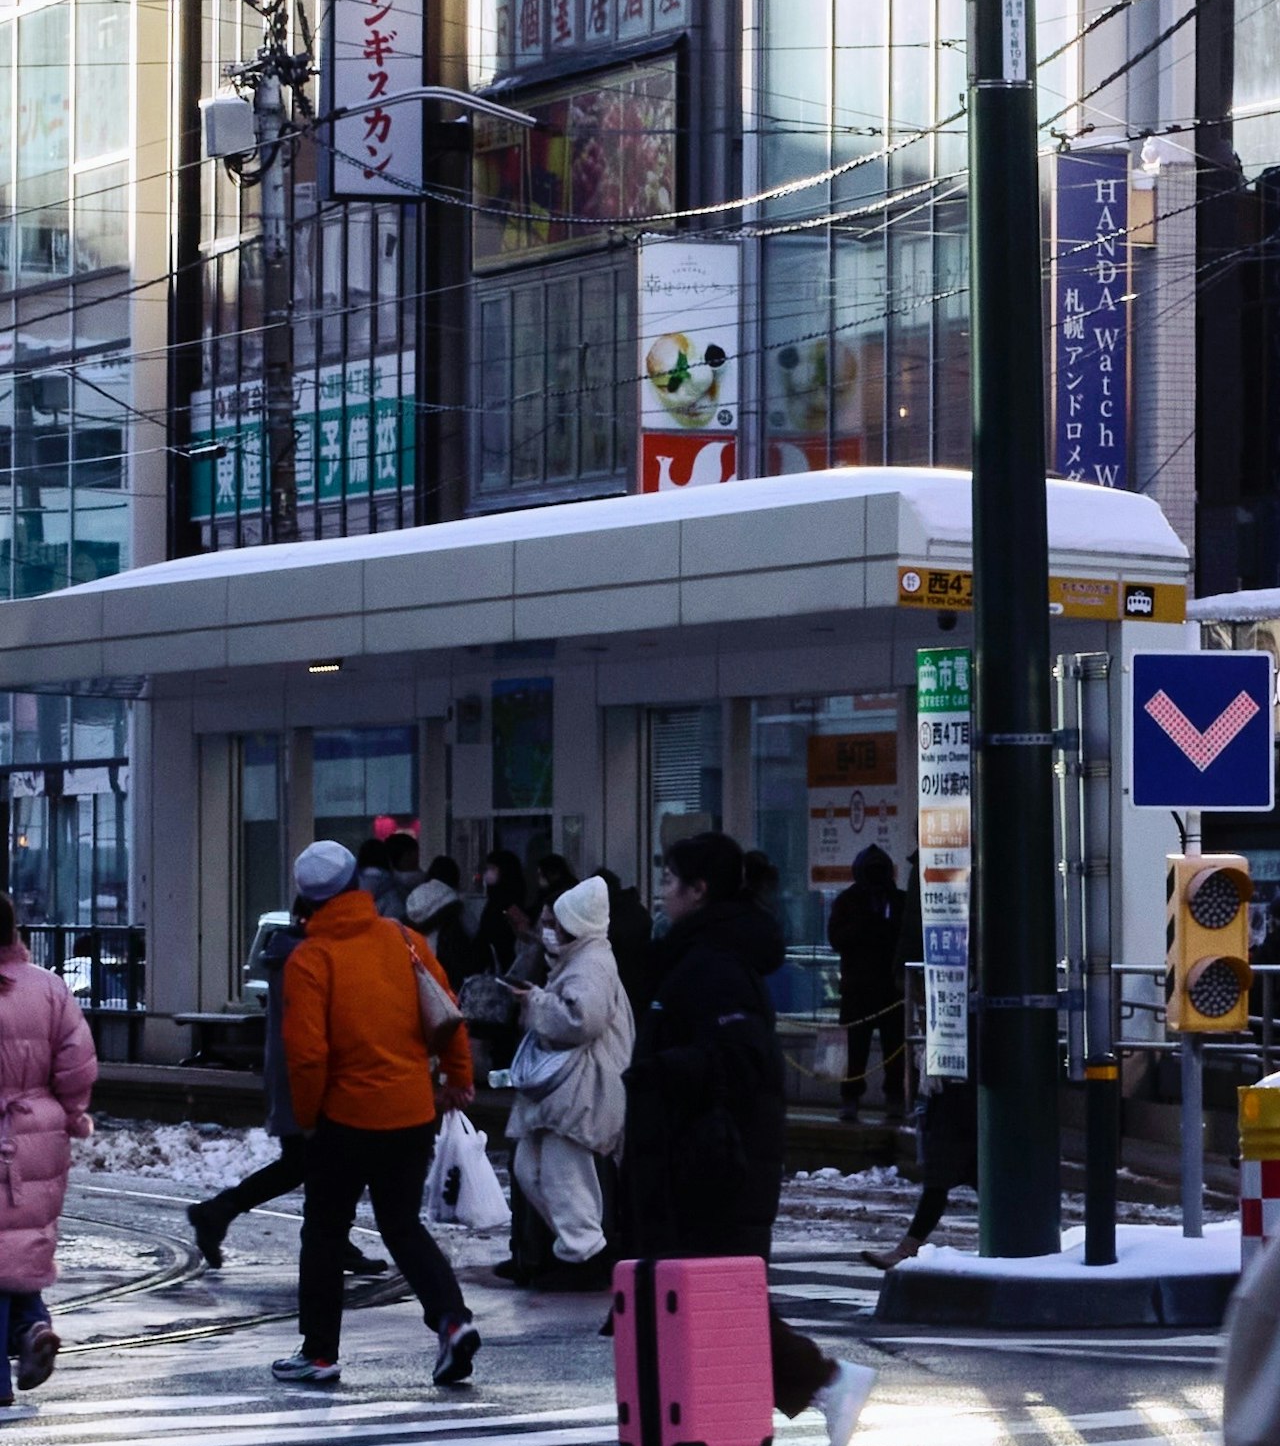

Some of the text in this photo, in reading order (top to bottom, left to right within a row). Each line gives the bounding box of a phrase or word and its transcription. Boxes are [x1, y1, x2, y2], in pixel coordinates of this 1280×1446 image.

[1095, 179, 1118, 312] HANDA
[1093, 327, 1119, 448] Watch
[938, 656, 969, 692] 市電
[919, 694, 969, 708] STREET CAR
[932, 722, 969, 746] 西4丁目
